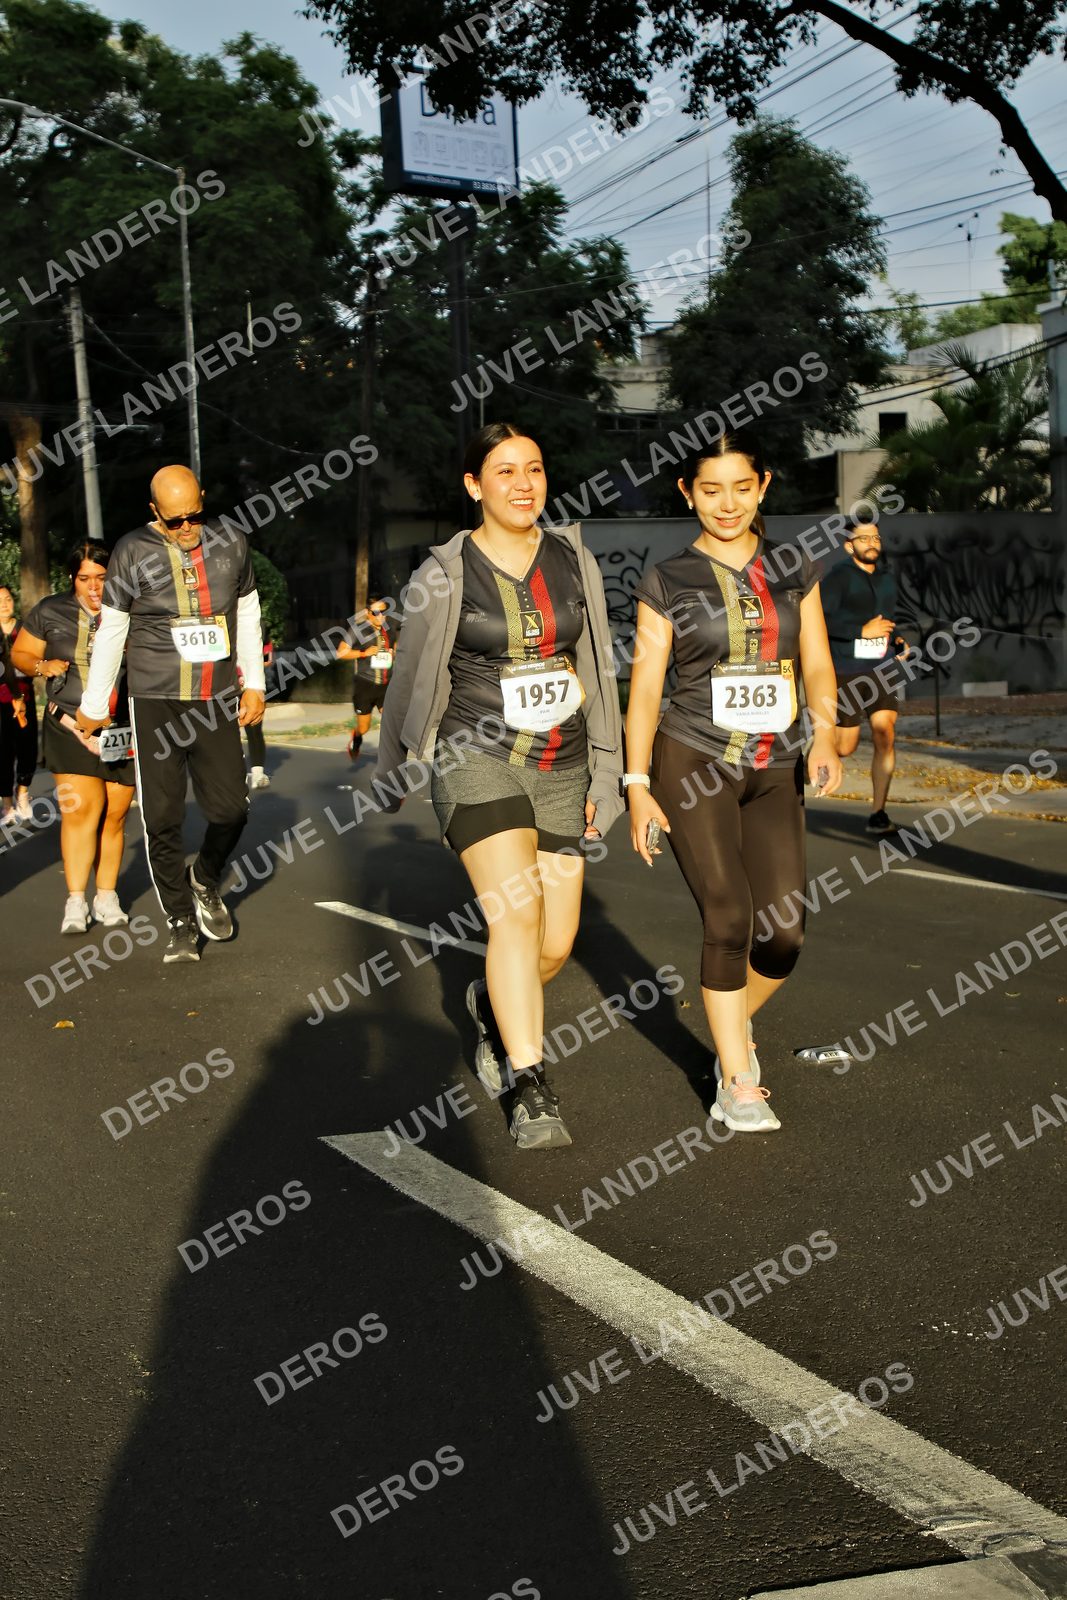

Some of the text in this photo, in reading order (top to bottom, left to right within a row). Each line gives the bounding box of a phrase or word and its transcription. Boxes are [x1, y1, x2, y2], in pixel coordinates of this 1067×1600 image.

[180, 630, 217, 647] 3618
[515, 679, 570, 709] 1957
[725, 684, 777, 709] 2363
[103, 732, 132, 748] 2217
